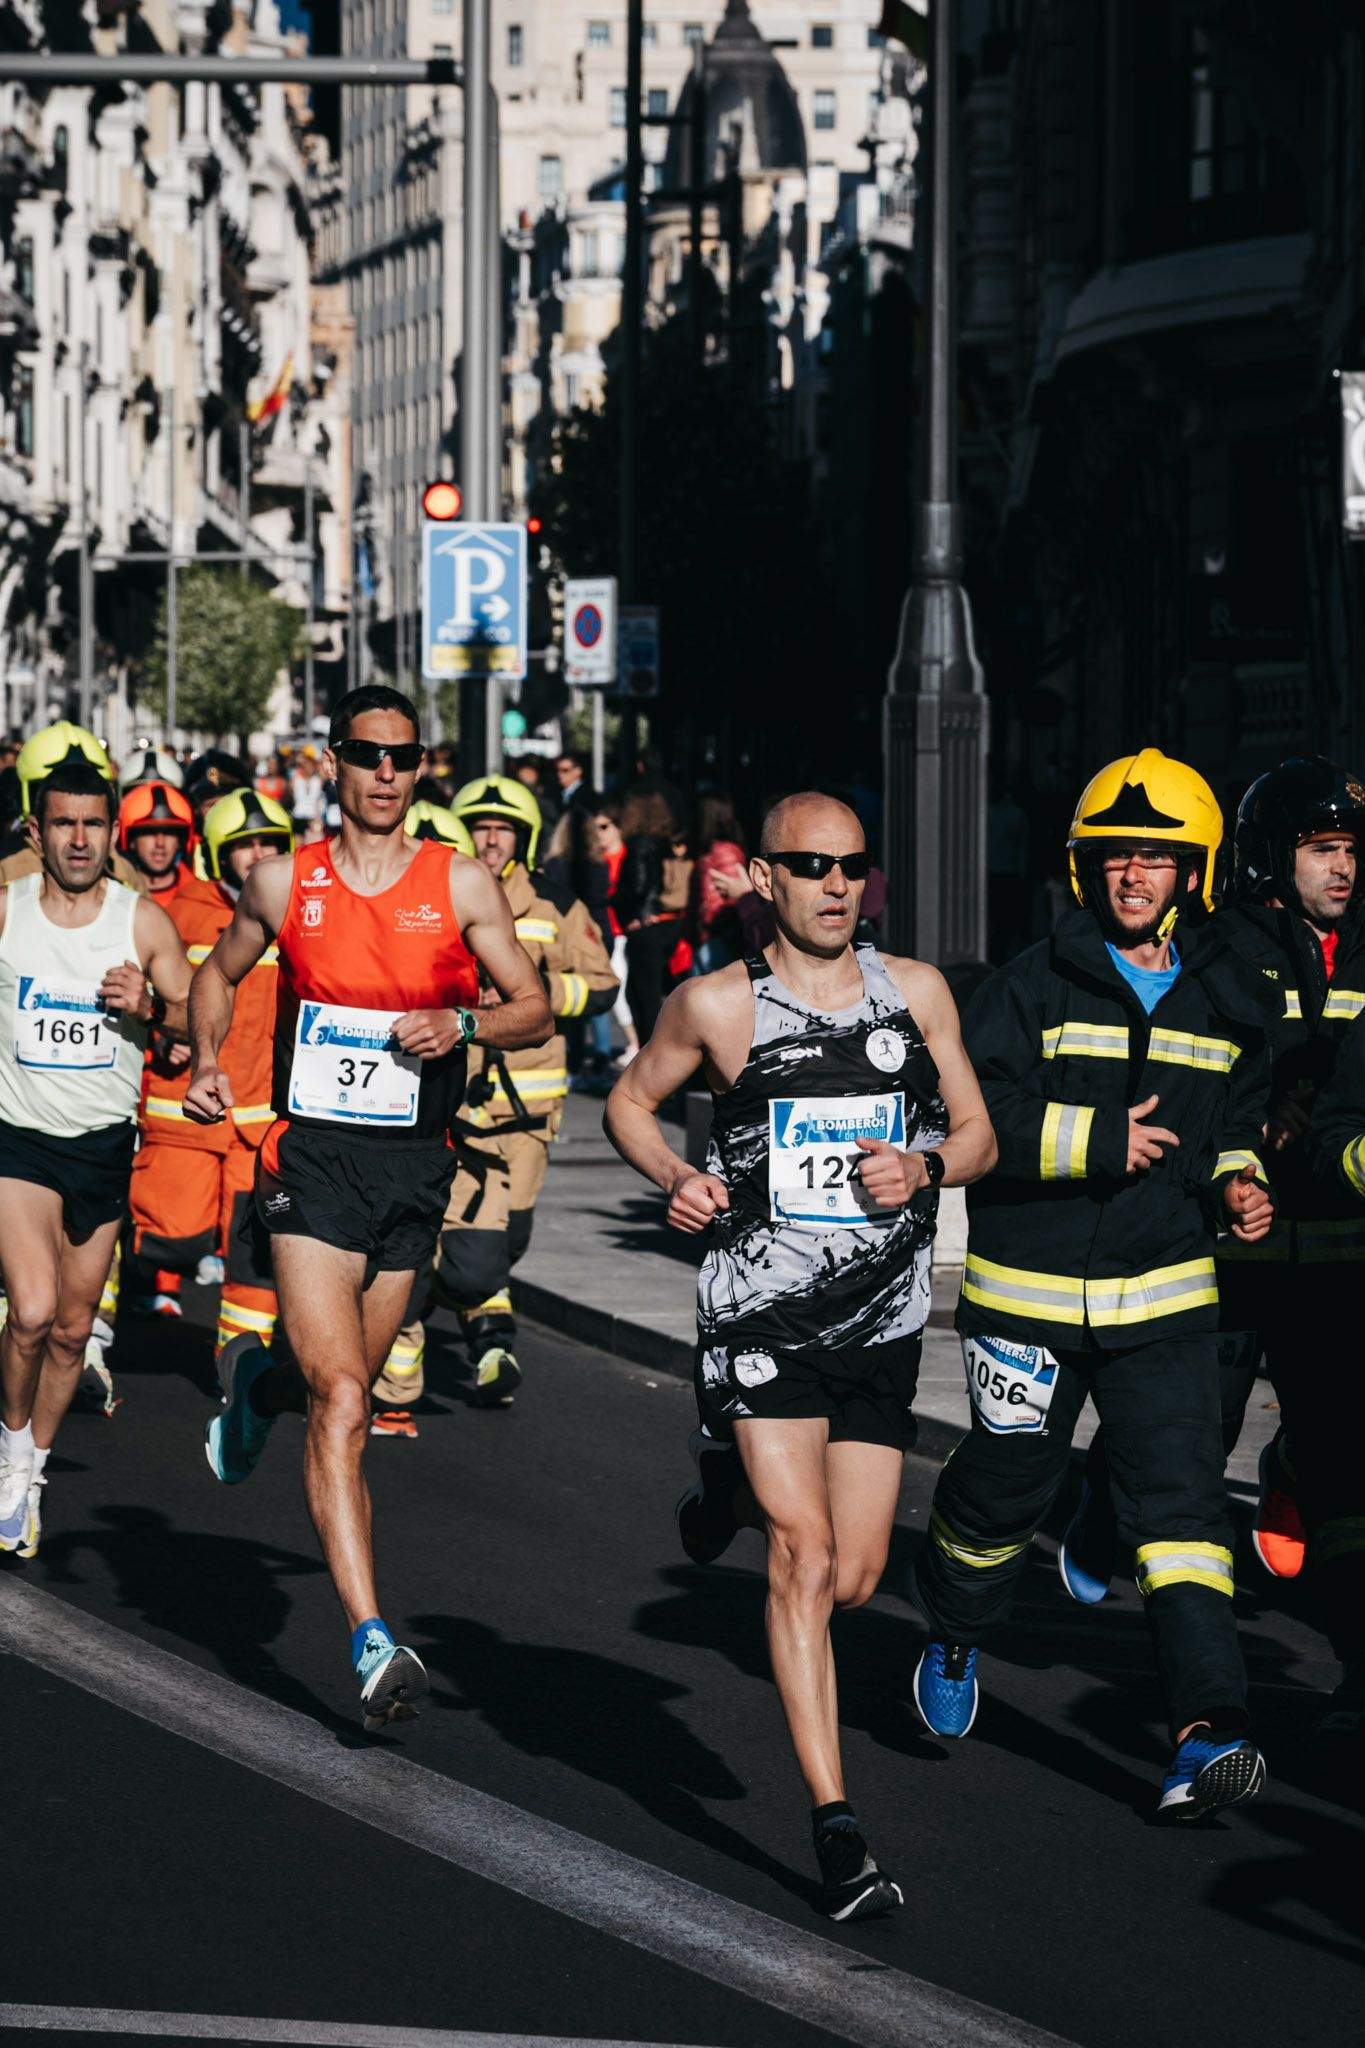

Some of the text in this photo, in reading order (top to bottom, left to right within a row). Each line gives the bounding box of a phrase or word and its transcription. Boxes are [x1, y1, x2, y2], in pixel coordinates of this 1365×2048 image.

[445, 547, 507, 627] P
[33, 1018, 99, 1046] 1661
[336, 1026, 395, 1041] BOMBERO
[337, 1058, 379, 1089] 37
[816, 1116, 886, 1132] BOMBEROS
[844, 1130, 855, 1140] de
[981, 1335, 1035, 1365] OMBEROS
[967, 1350, 1029, 1406] 1056
